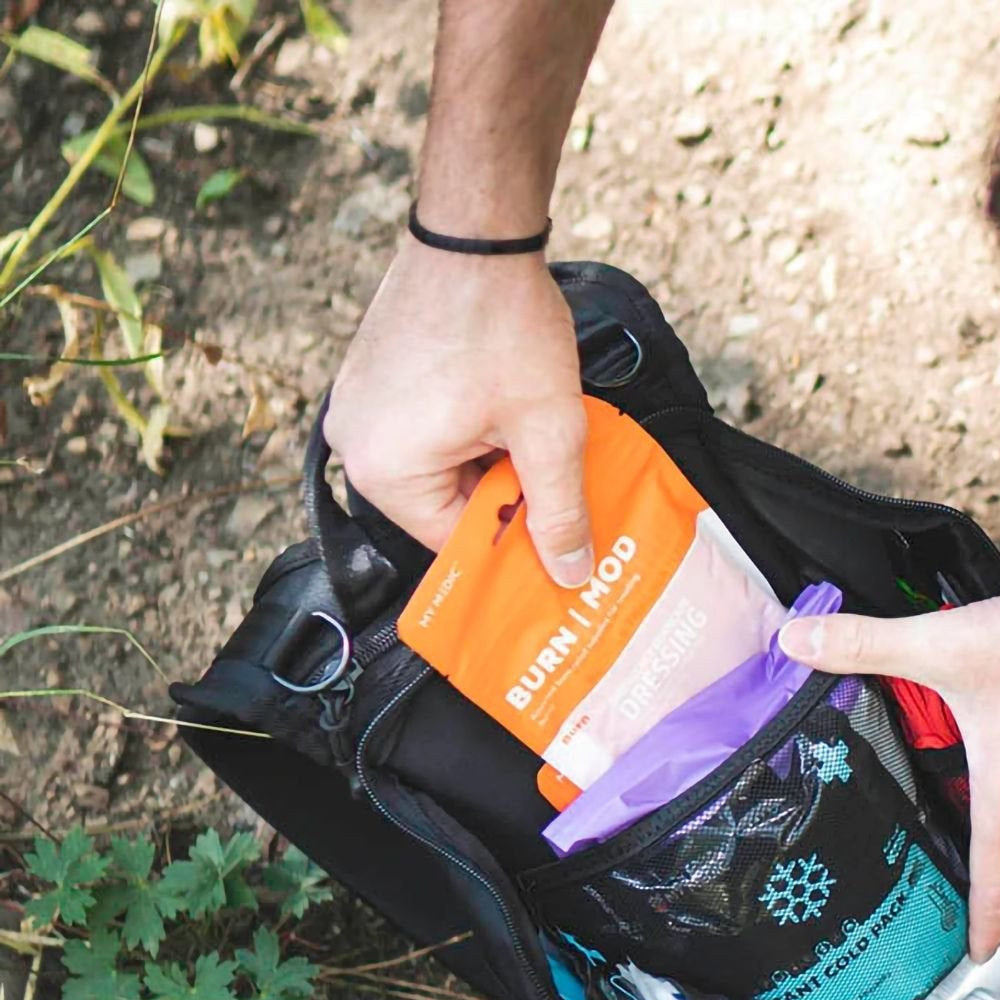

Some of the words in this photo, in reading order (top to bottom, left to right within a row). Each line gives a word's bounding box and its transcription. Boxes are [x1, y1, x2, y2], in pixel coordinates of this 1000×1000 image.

[505, 625, 579, 711] BURN
[580, 535, 637, 610] MOD
[619, 605, 708, 721] DRESSING
[824, 937, 870, 980] COLD
[870, 893, 907, 938] PACK
